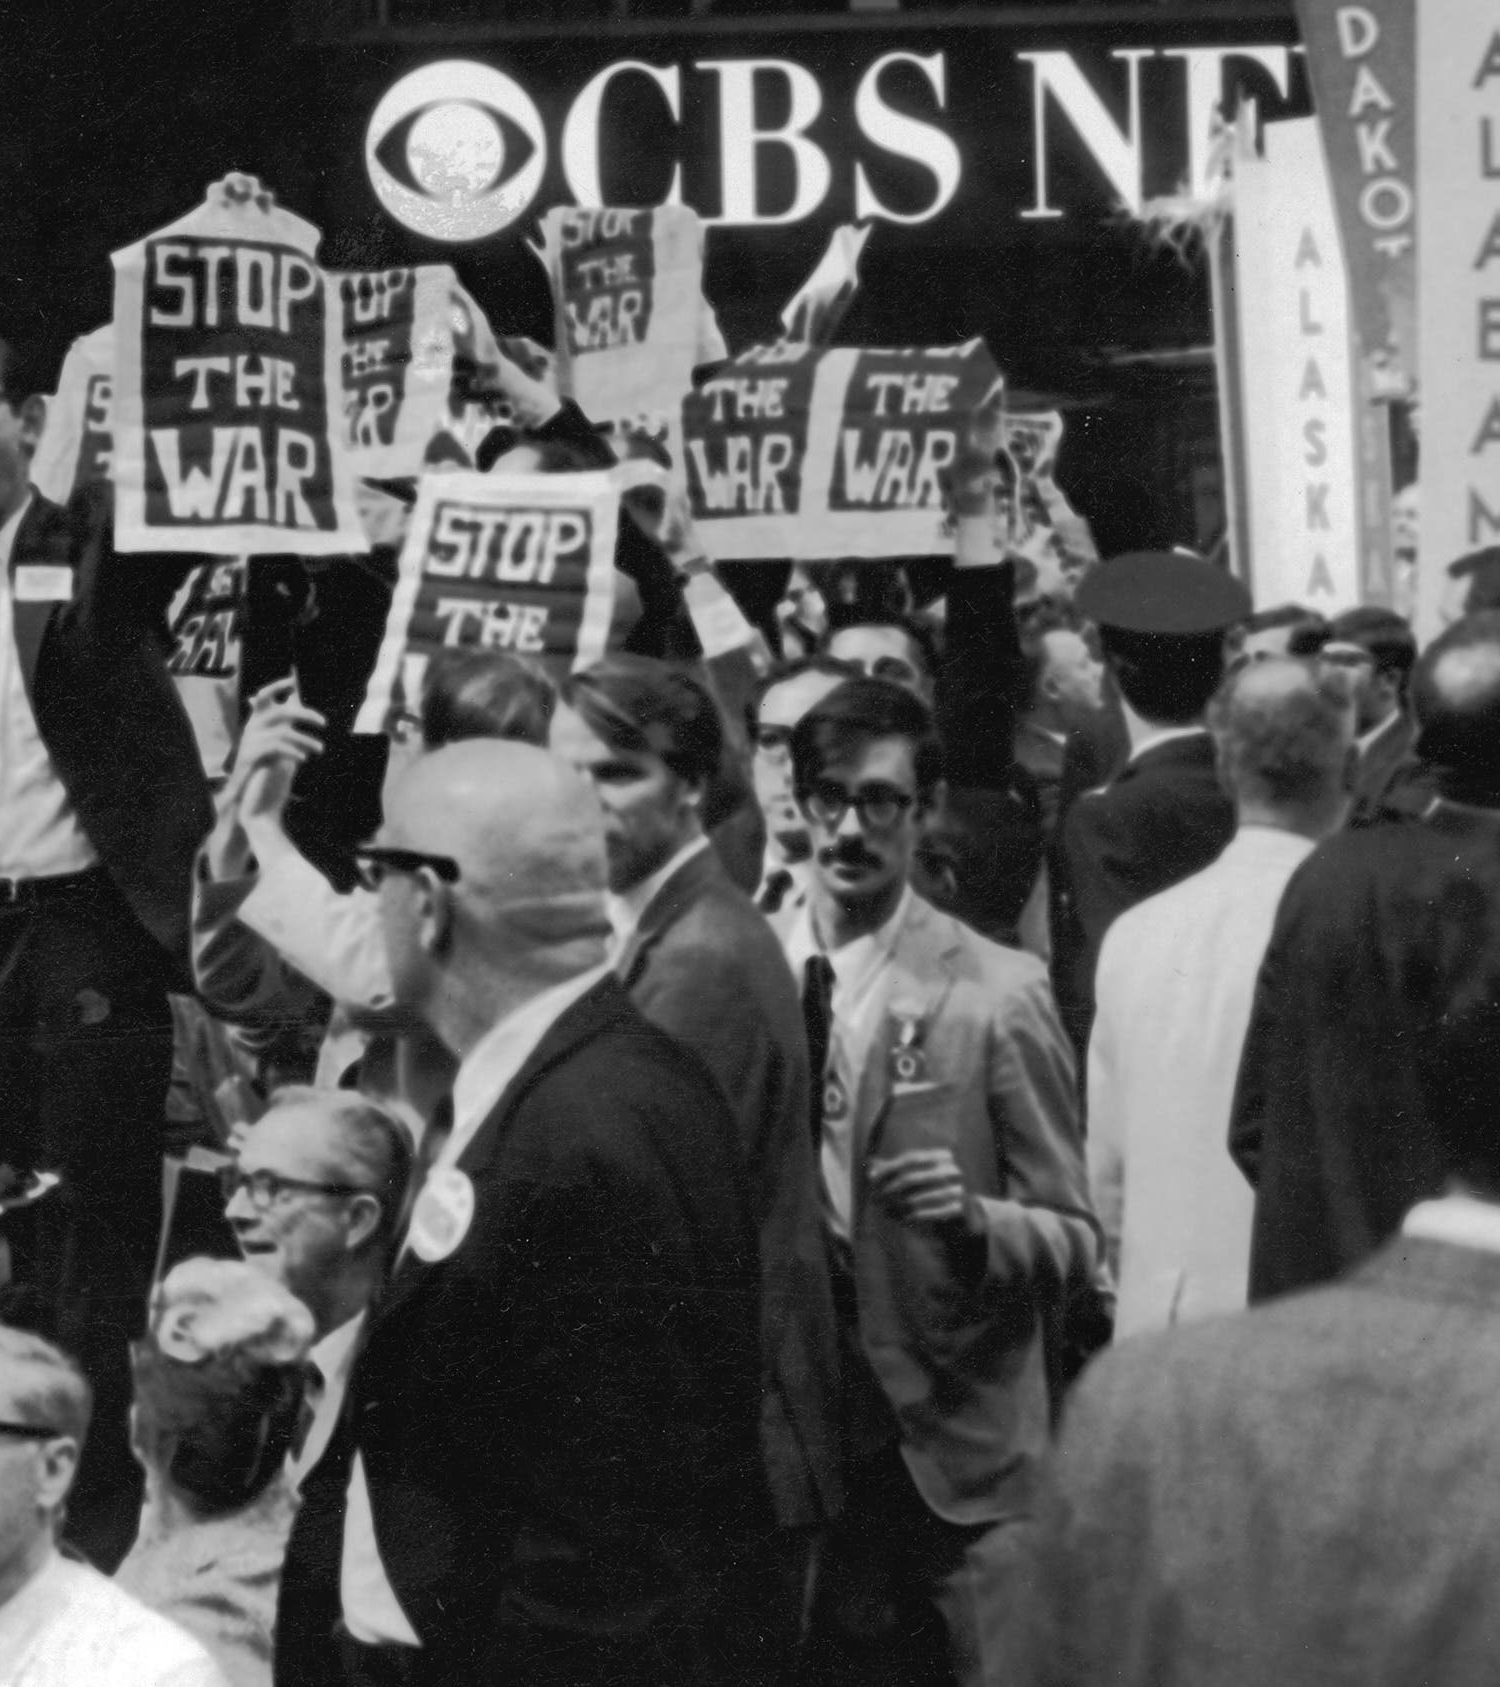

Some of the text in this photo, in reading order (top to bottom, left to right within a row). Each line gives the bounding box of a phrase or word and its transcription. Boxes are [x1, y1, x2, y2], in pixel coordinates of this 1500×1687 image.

[562, 46, 1304, 225] CBS NE
[1336, 7, 1411, 258] DAKOT
[151, 246, 316, 332] STOP
[565, 289, 643, 346] WAR
[175, 354, 300, 410] THE
[350, 339, 390, 378] HE
[866, 373, 959, 416] THE
[702, 378, 788, 422] THE
[1295, 226, 1336, 597] ALASKA
[151, 426, 317, 526] WAR
[688, 434, 792, 512] WAR
[844, 429, 956, 503] WAR
[426, 506, 586, 584] STOP
[436, 596, 548, 651] THE
